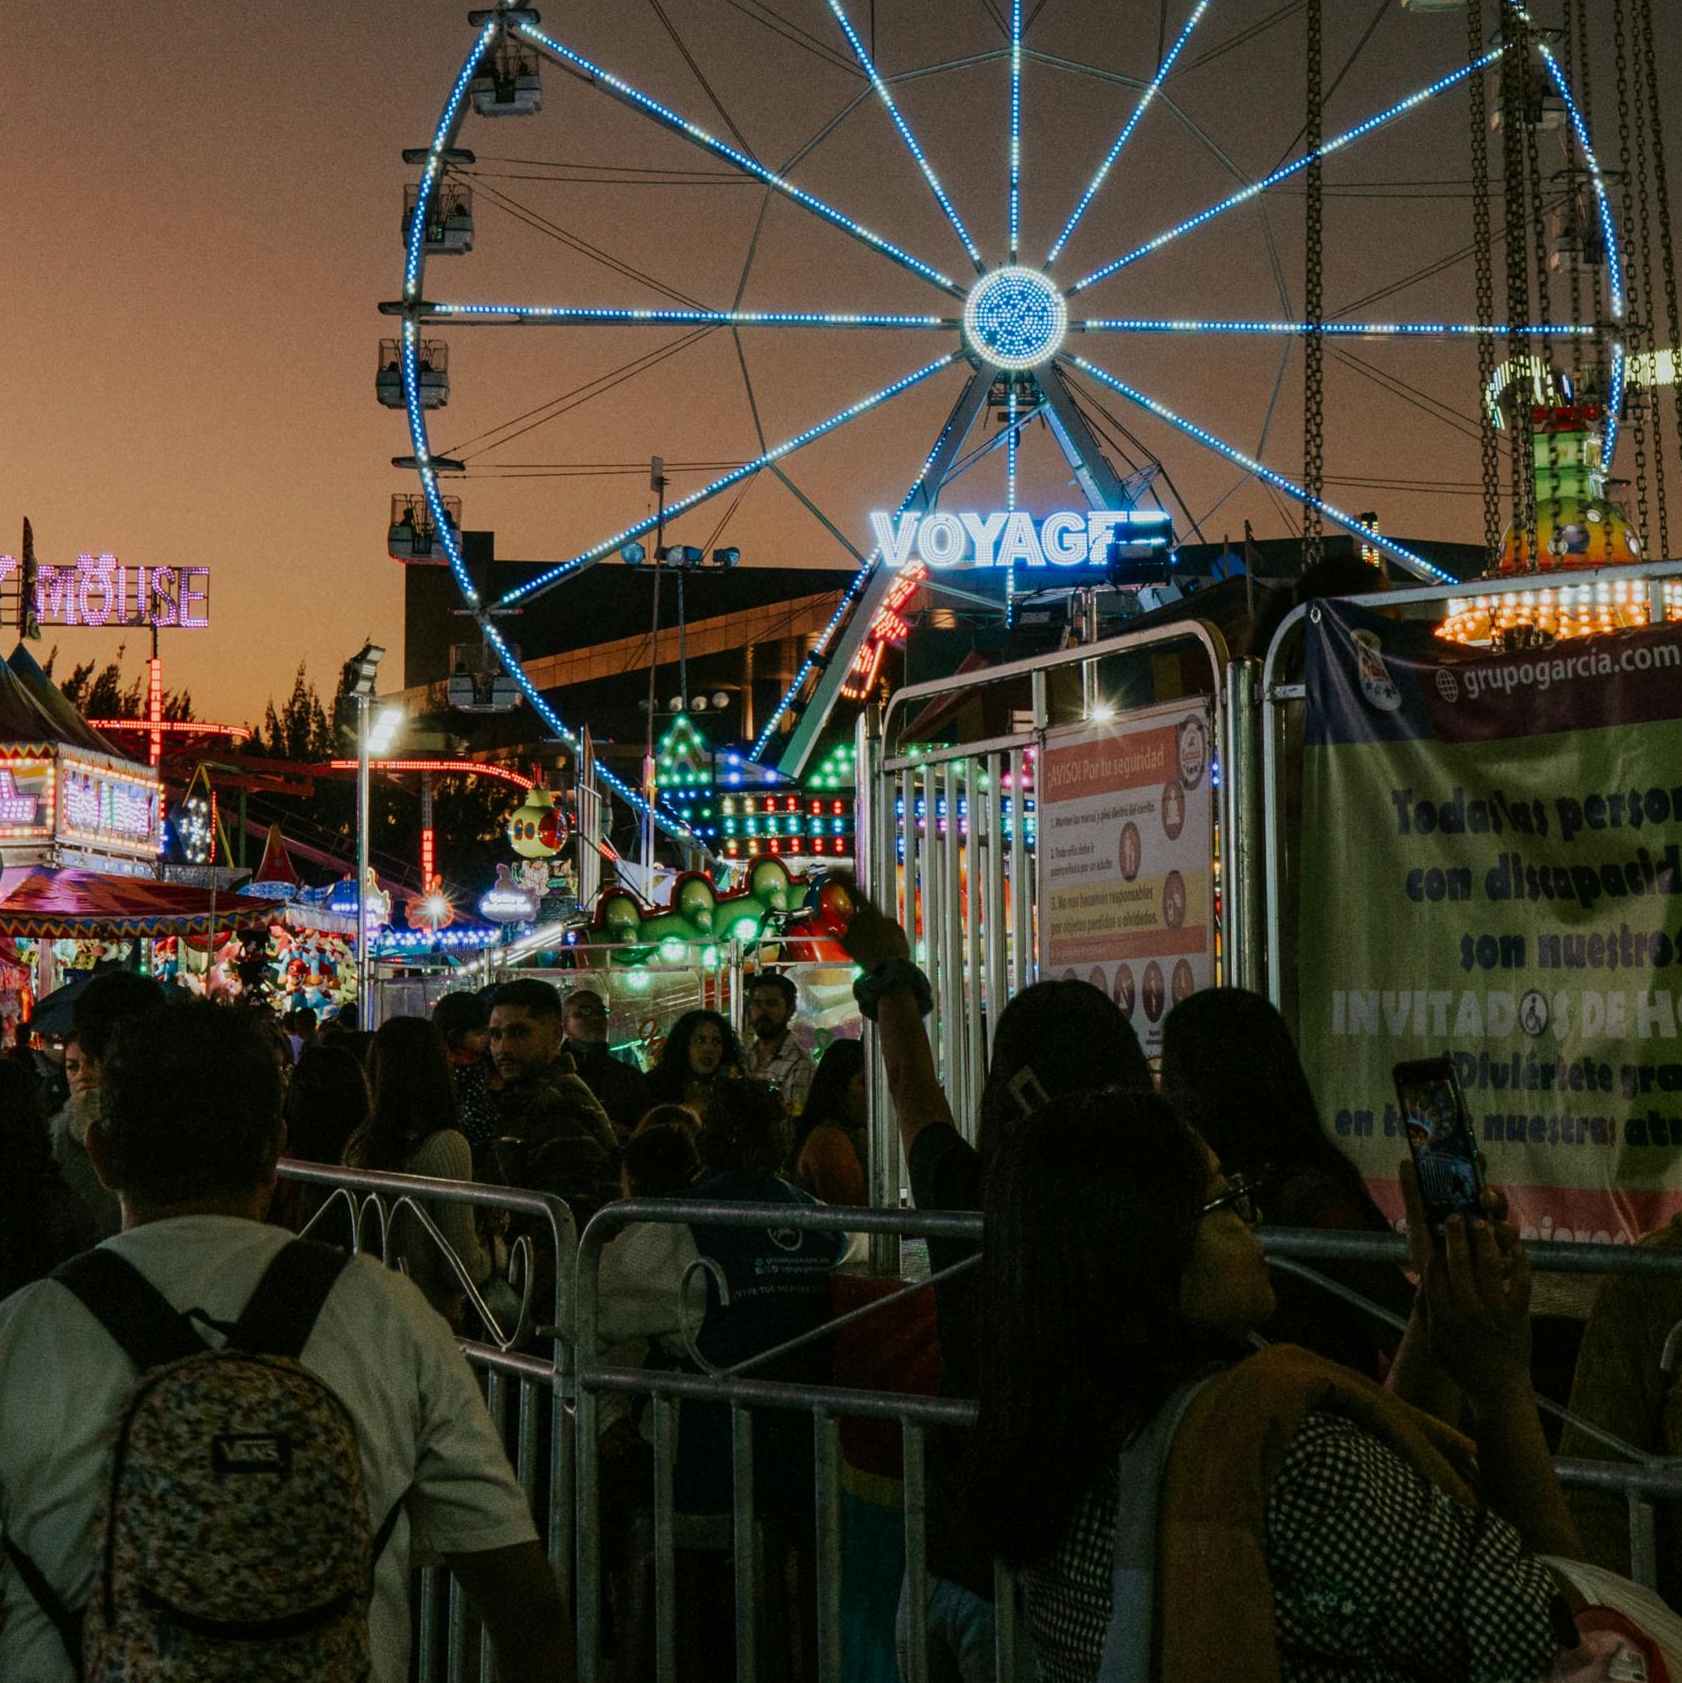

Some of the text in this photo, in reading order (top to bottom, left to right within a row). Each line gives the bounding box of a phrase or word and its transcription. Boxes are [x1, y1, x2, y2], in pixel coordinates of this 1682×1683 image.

[869, 510, 1172, 566] VOYAGE
[36, 553, 210, 628] MOUSE
[1048, 761, 1081, 793] ¡AVISO!
[1084, 759, 1099, 780] Por
[1101, 757, 1111, 777] tu
[1113, 744, 1165, 779] seguridad
[1109, 884, 1153, 907] responsables
[1405, 866, 1472, 903] con
[1460, 932, 1526, 972] son
[1581, 990, 1628, 1038] DE
[1335, 1110, 1374, 1137] en
